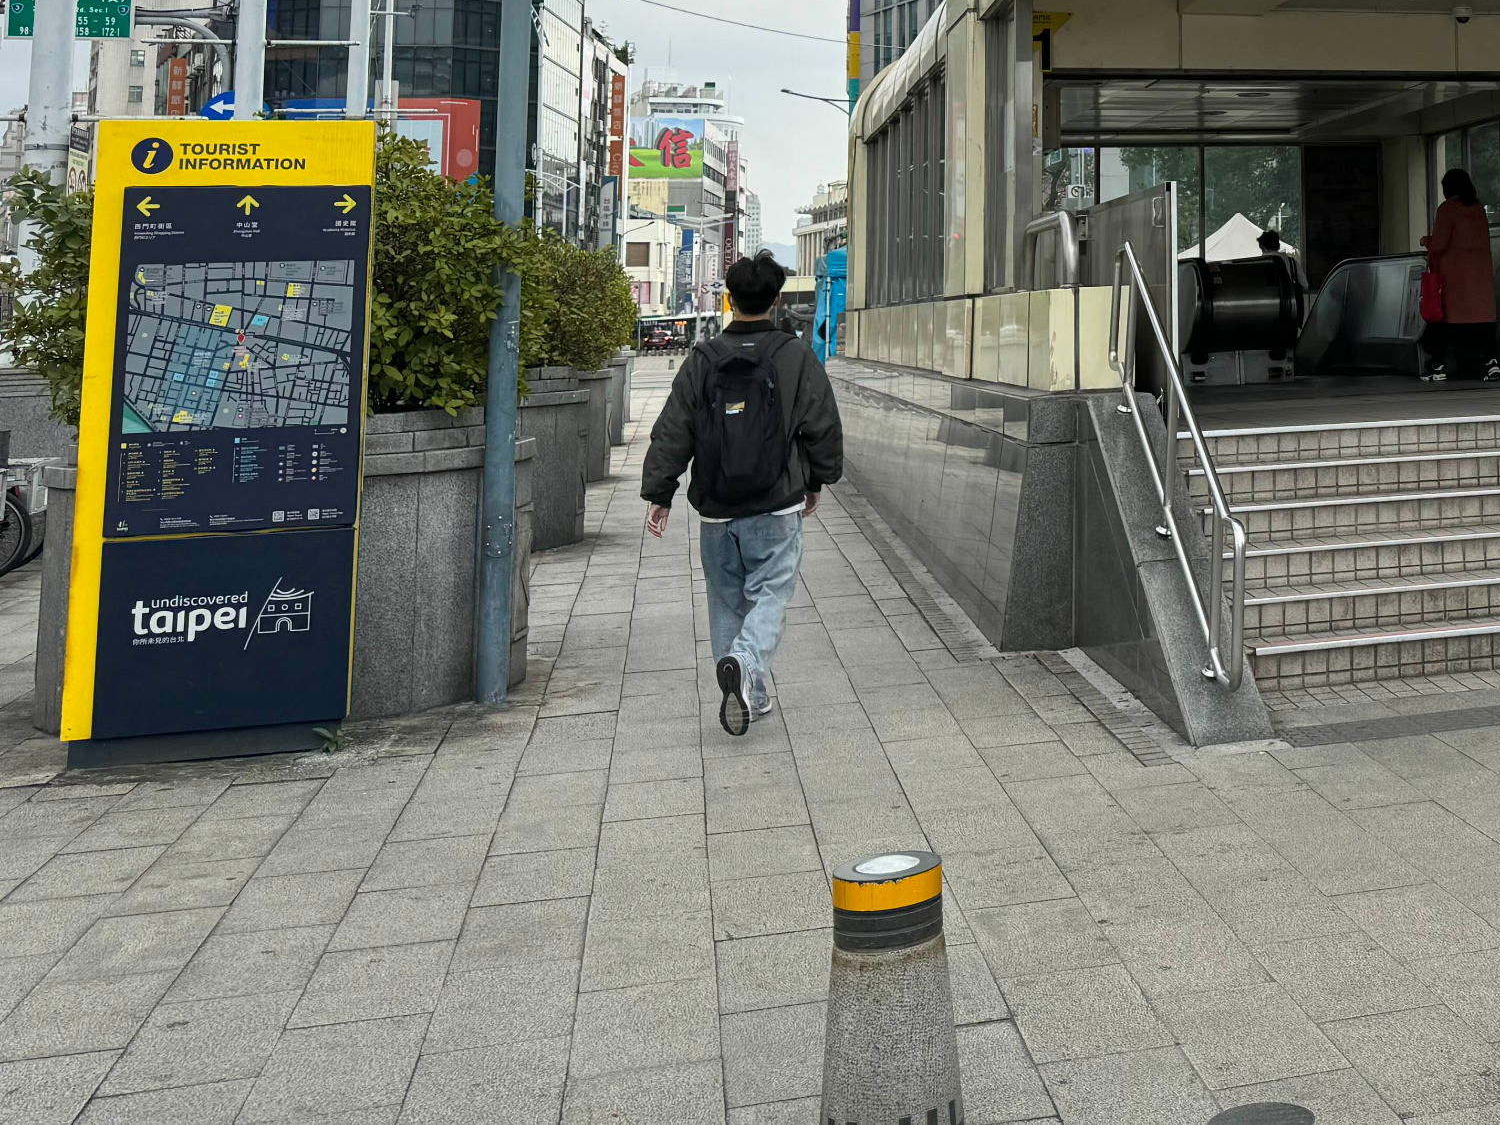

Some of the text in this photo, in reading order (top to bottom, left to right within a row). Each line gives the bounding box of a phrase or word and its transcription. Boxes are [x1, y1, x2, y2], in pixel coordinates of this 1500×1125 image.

[105, 16, 116, 26] 59
[179, 143, 260, 156] TOURIST
[178, 158, 306, 170] INFORMATION
[134, 222, 172, 230] 西門町街區
[151, 591, 248, 609] undiscovered
[131, 600, 247, 642] taipei
